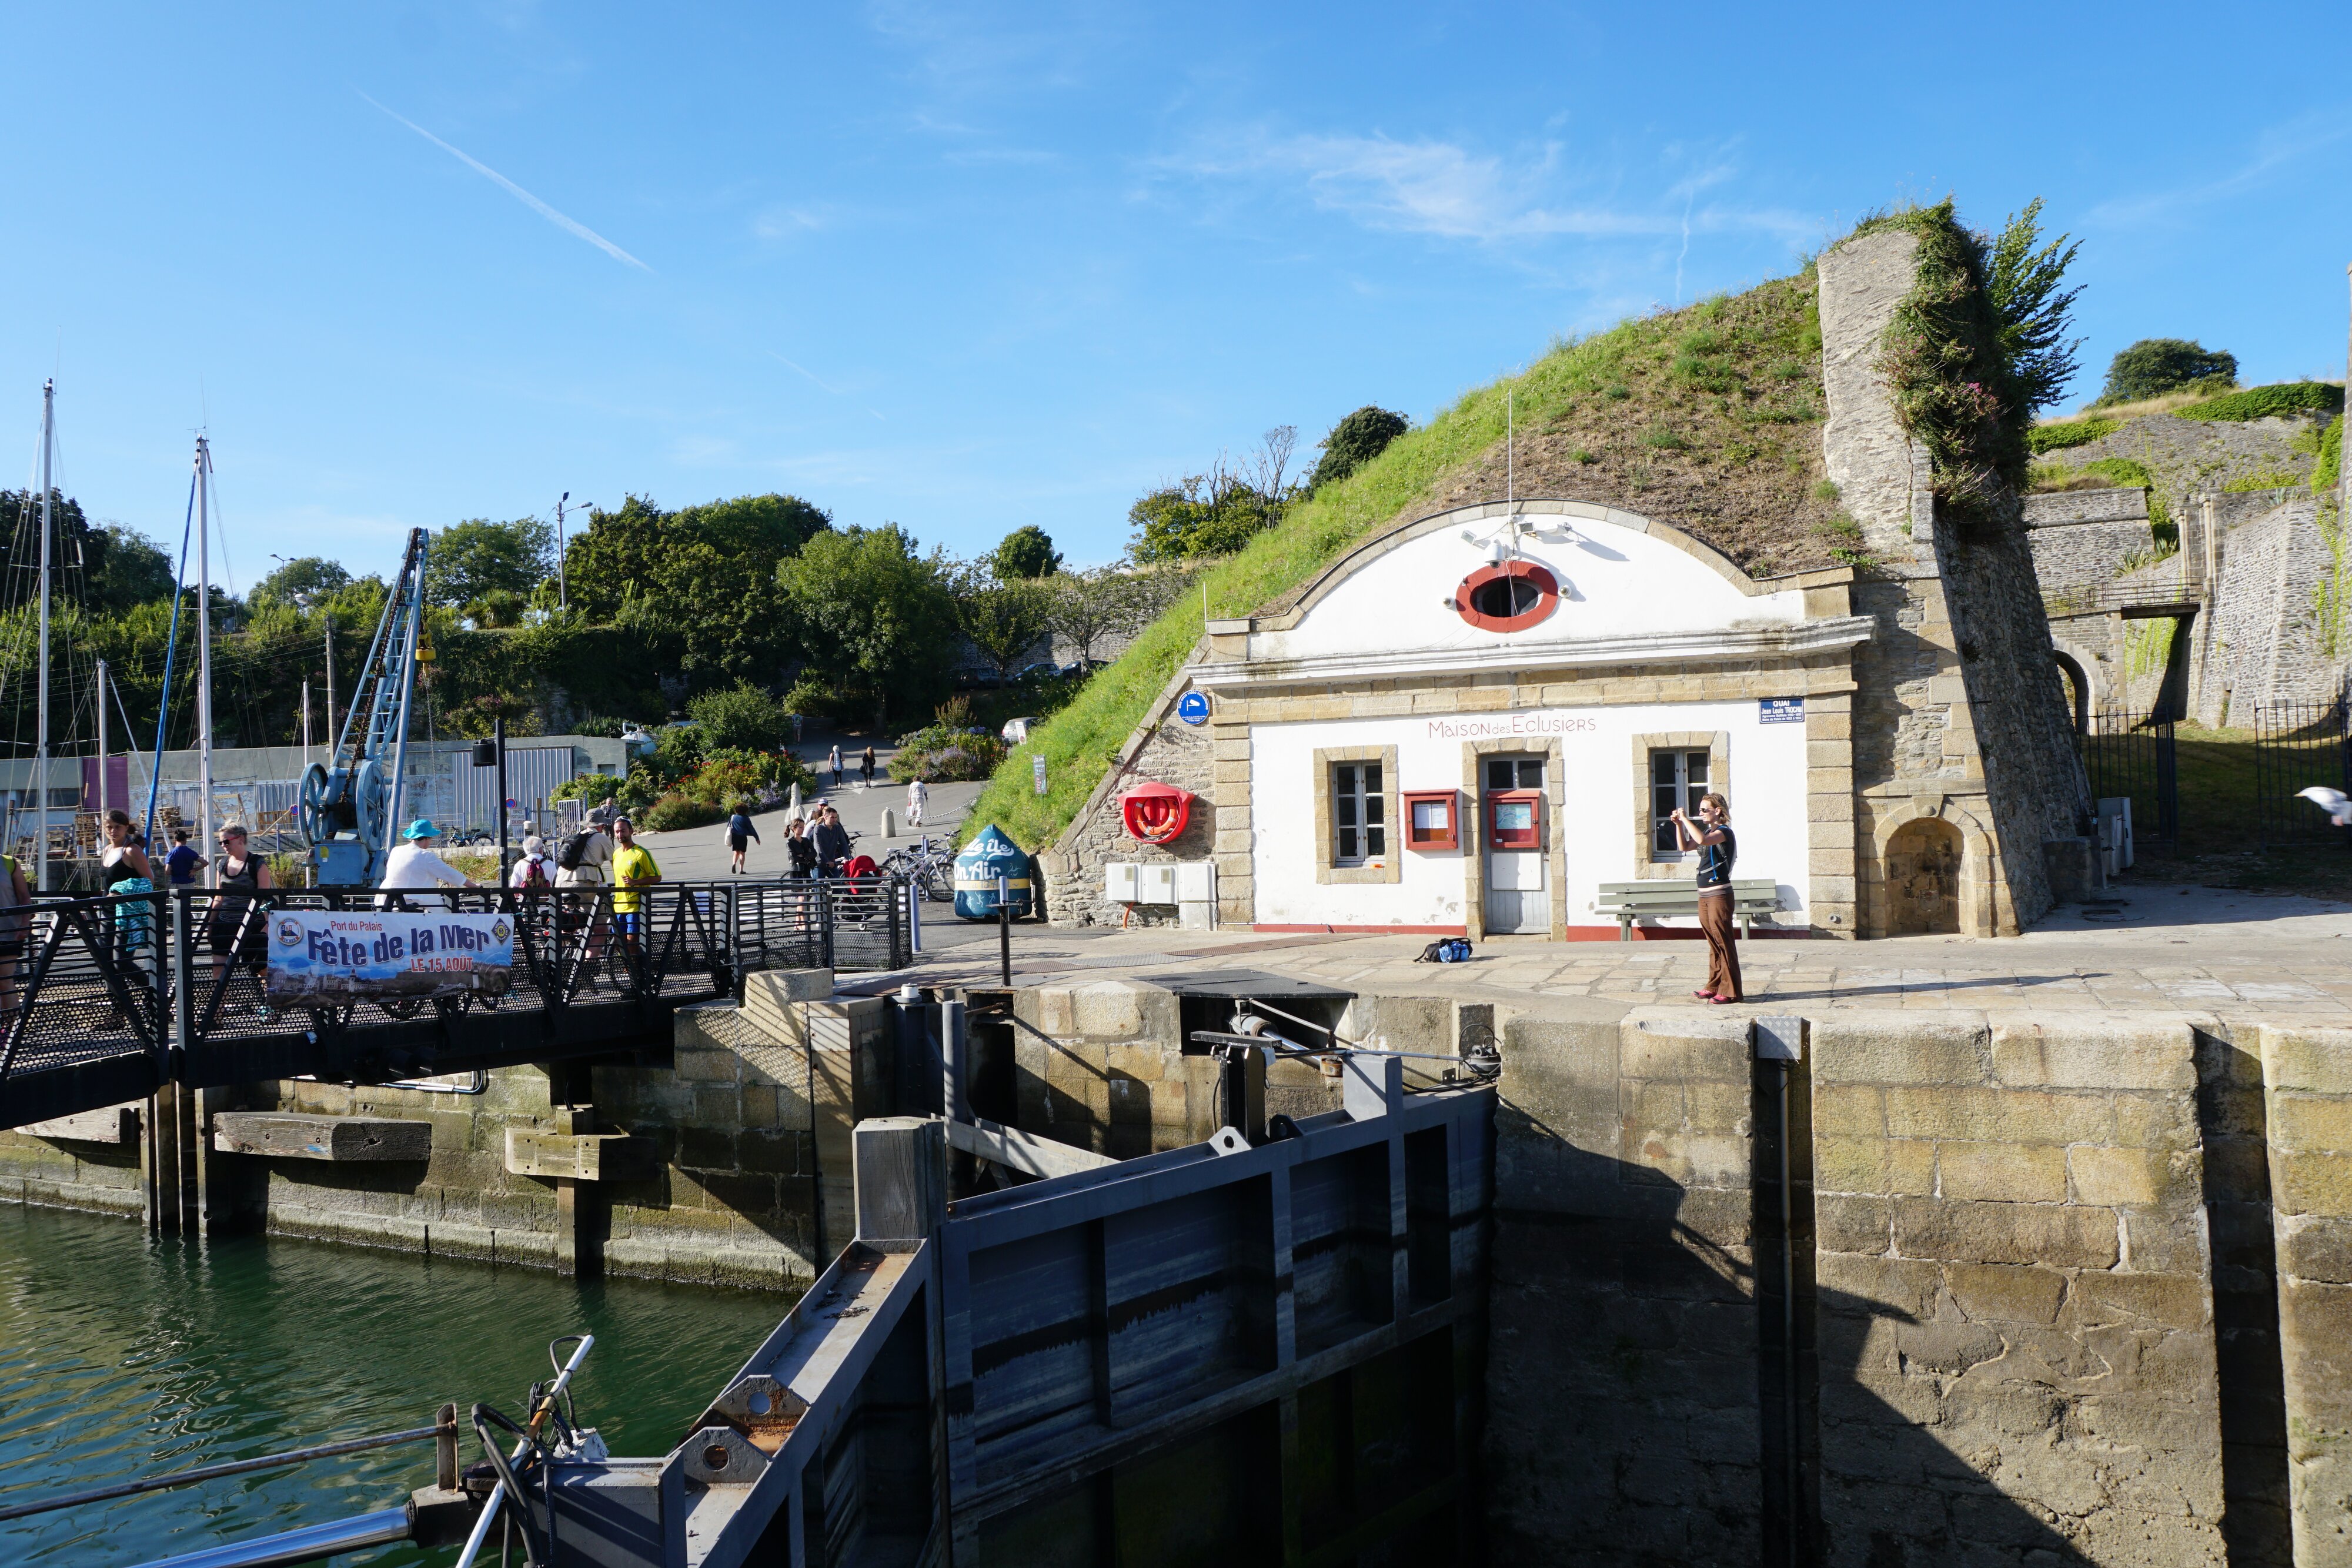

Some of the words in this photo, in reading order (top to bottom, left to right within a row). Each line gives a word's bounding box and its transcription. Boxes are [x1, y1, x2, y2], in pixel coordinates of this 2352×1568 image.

[1429, 720, 1490, 738] Maison
[1492, 723, 1511, 734] des
[1513, 715, 1596, 733] Eclusiers
[954, 861, 969, 880] On
[969, 861, 1001, 880] Air
[330, 921, 346, 931] Port
[349, 921, 358, 931] du
[359, 921, 382, 931] Palais
[308, 929, 368, 966] Fête
[373, 932, 404, 964] de
[411, 928, 435, 955] la
[439, 925, 489, 952] Mer
[411, 958, 425, 972] LE
[428, 958, 443, 972] 15
[446, 954, 473, 972] AOÛT
